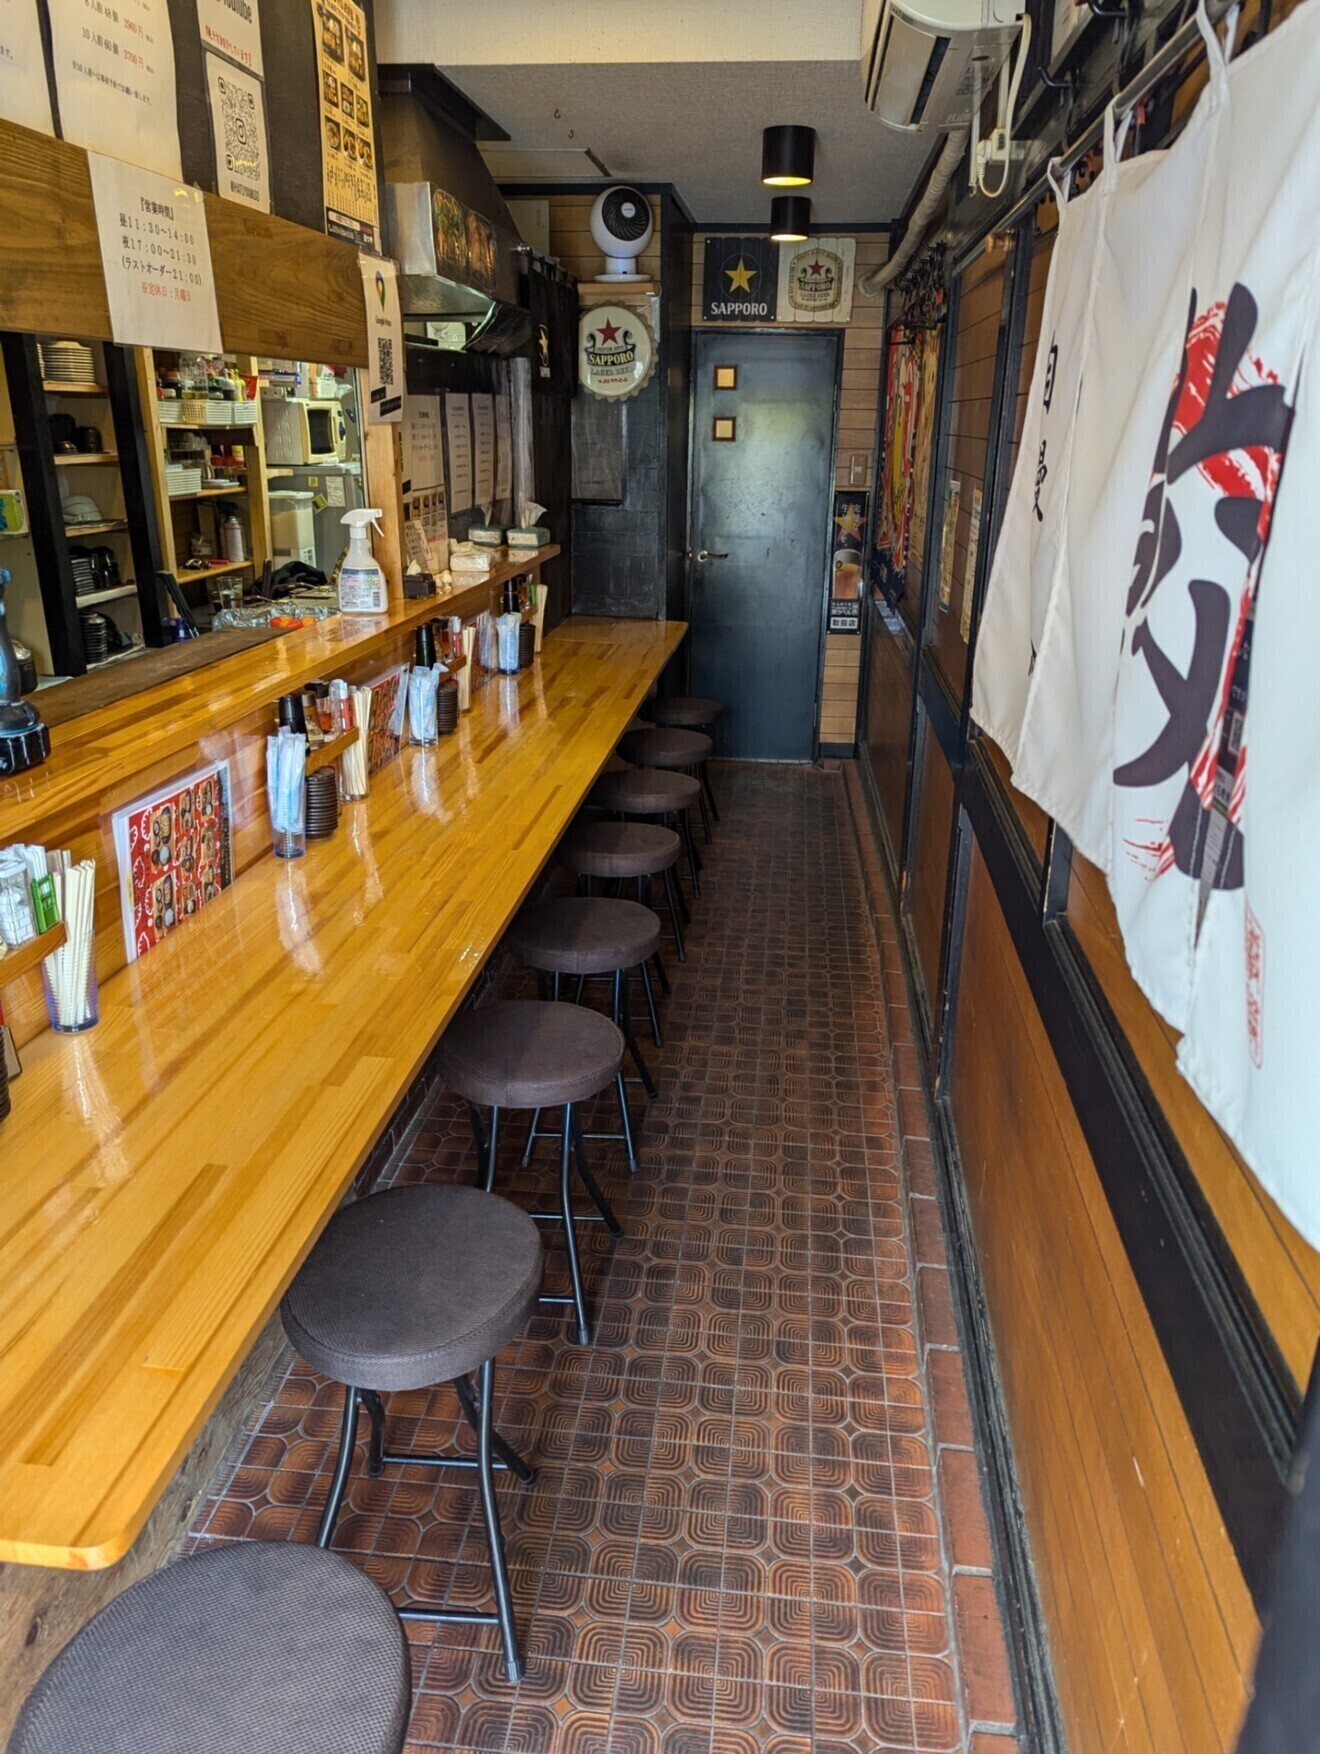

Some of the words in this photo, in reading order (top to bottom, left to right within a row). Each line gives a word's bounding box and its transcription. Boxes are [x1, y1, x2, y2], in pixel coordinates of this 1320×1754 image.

[800, 282, 832, 291] SAPPORO
[710, 301, 768, 316] SAPPORO
[588, 350, 634, 366] SAPPORO
